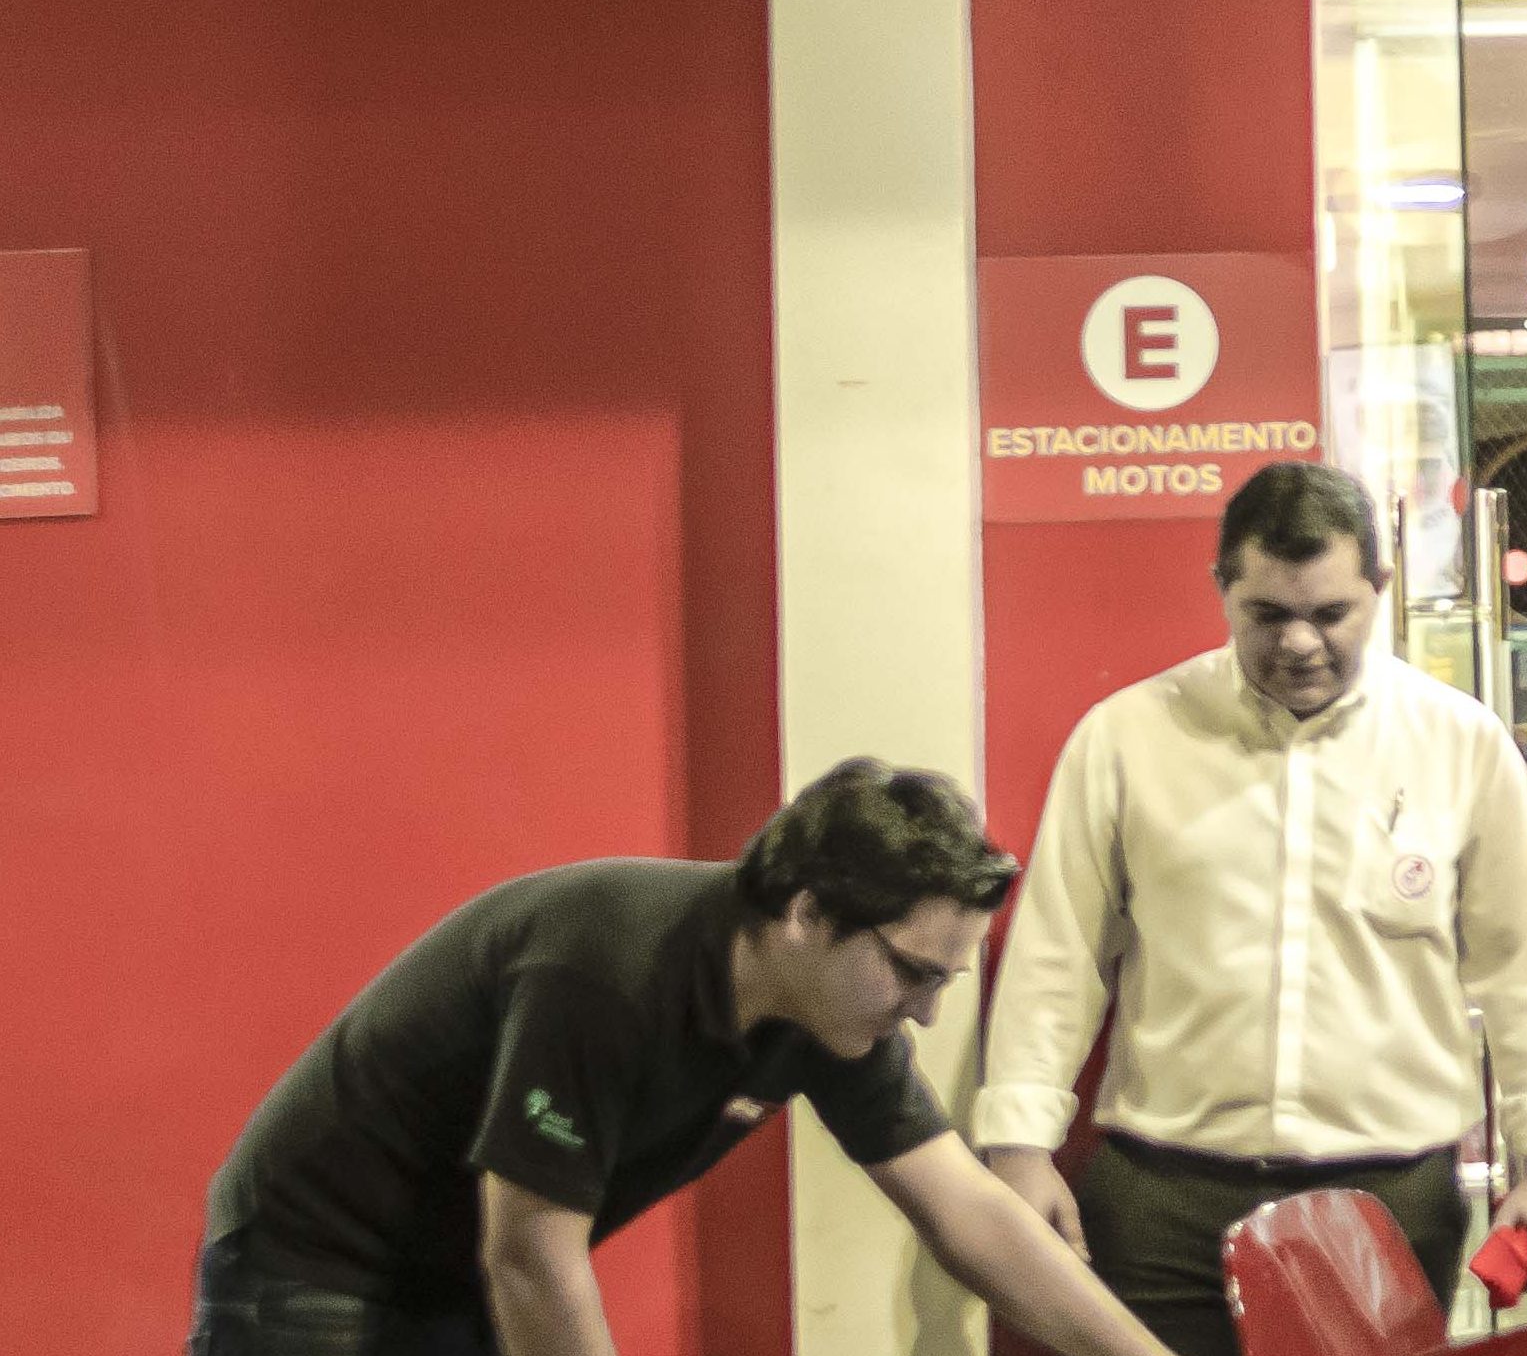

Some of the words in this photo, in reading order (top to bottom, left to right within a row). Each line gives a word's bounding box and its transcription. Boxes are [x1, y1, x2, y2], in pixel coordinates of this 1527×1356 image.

[1124, 305, 1178, 379] E
[987, 421, 1318, 458] ESTACIONAMENTO
[1083, 462, 1223, 496] MOTOS
